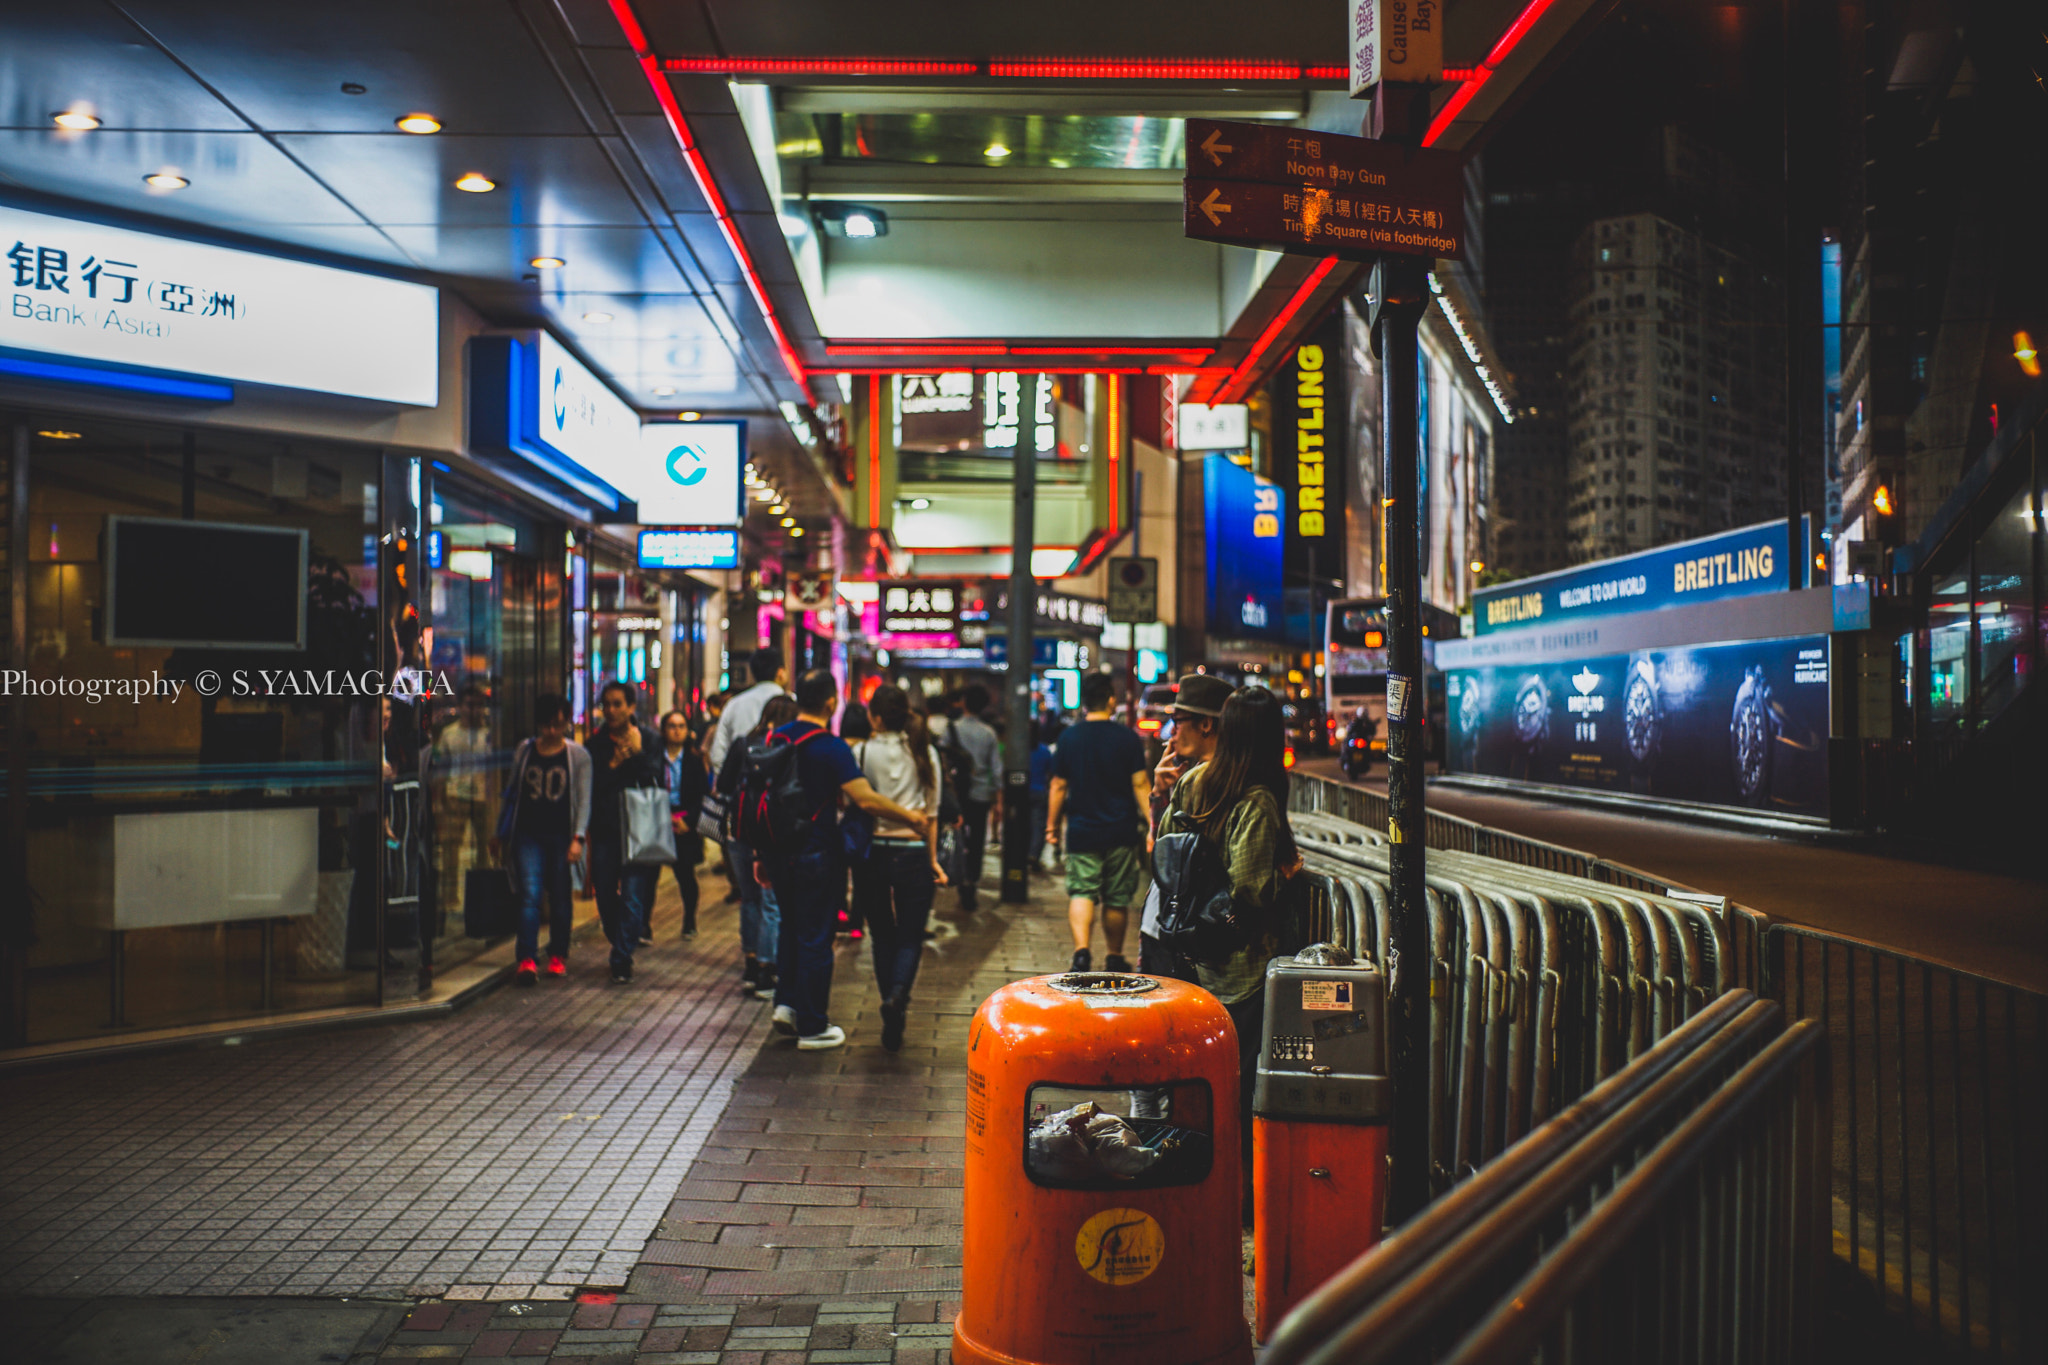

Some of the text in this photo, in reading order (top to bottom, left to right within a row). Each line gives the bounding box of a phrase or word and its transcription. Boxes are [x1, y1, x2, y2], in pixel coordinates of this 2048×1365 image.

[1412, 0, 1436, 33] Bay
[1287, 137, 1321, 159] 午炮
[1287, 160, 1386, 186] Noon Day Gun
[1283, 193, 1443, 230] 時廣場(經行人天橋)
[1325, 222, 1368, 240] Square
[1370, 227, 1391, 243] (via
[1394, 230, 1456, 252] footbridge)
[13, 293, 171, 338] Bank (Asia)
[1297, 344, 1325, 536] BREITLING
[1488, 545, 1773, 625] BREITLING WELCOME TO OUR WORLD BREITLING
